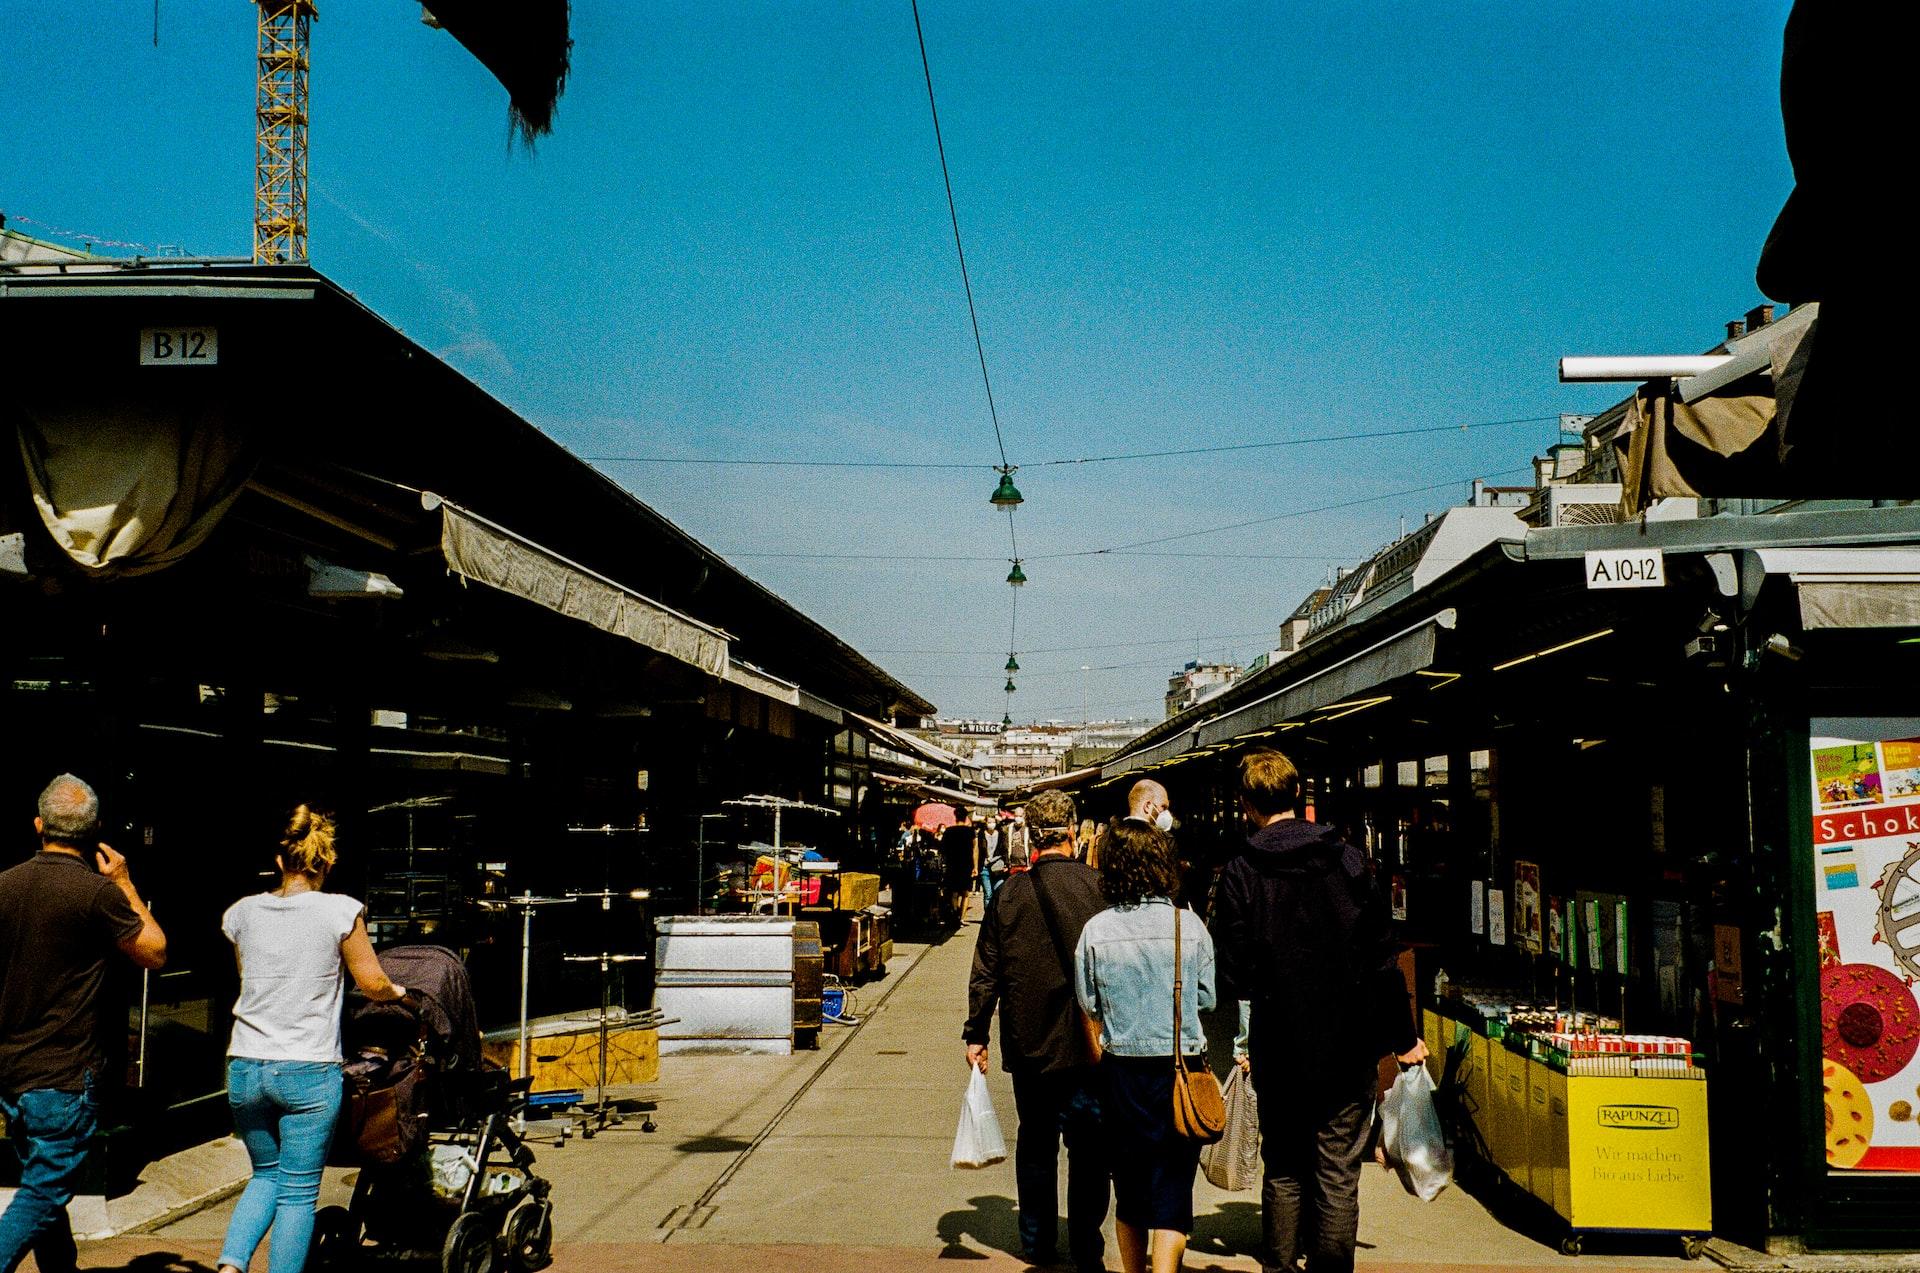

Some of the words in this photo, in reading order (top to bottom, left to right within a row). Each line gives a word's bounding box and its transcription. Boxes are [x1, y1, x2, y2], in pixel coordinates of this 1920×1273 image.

[153, 332, 173, 359] B
[180, 331, 207, 359] 12
[1592, 559, 1612, 582] A
[1615, 557, 1657, 582] 10-12
[1887, 755, 1910, 764] Blue
[1820, 807, 1920, 841] Schok
[1601, 1109, 1676, 1125] RAPUNZEL
[1595, 1145, 1622, 1161] Wir
[1627, 1146, 1682, 1163] machen
[1592, 1166, 1616, 1180] Bio
[1619, 1171, 1643, 1182] aus
